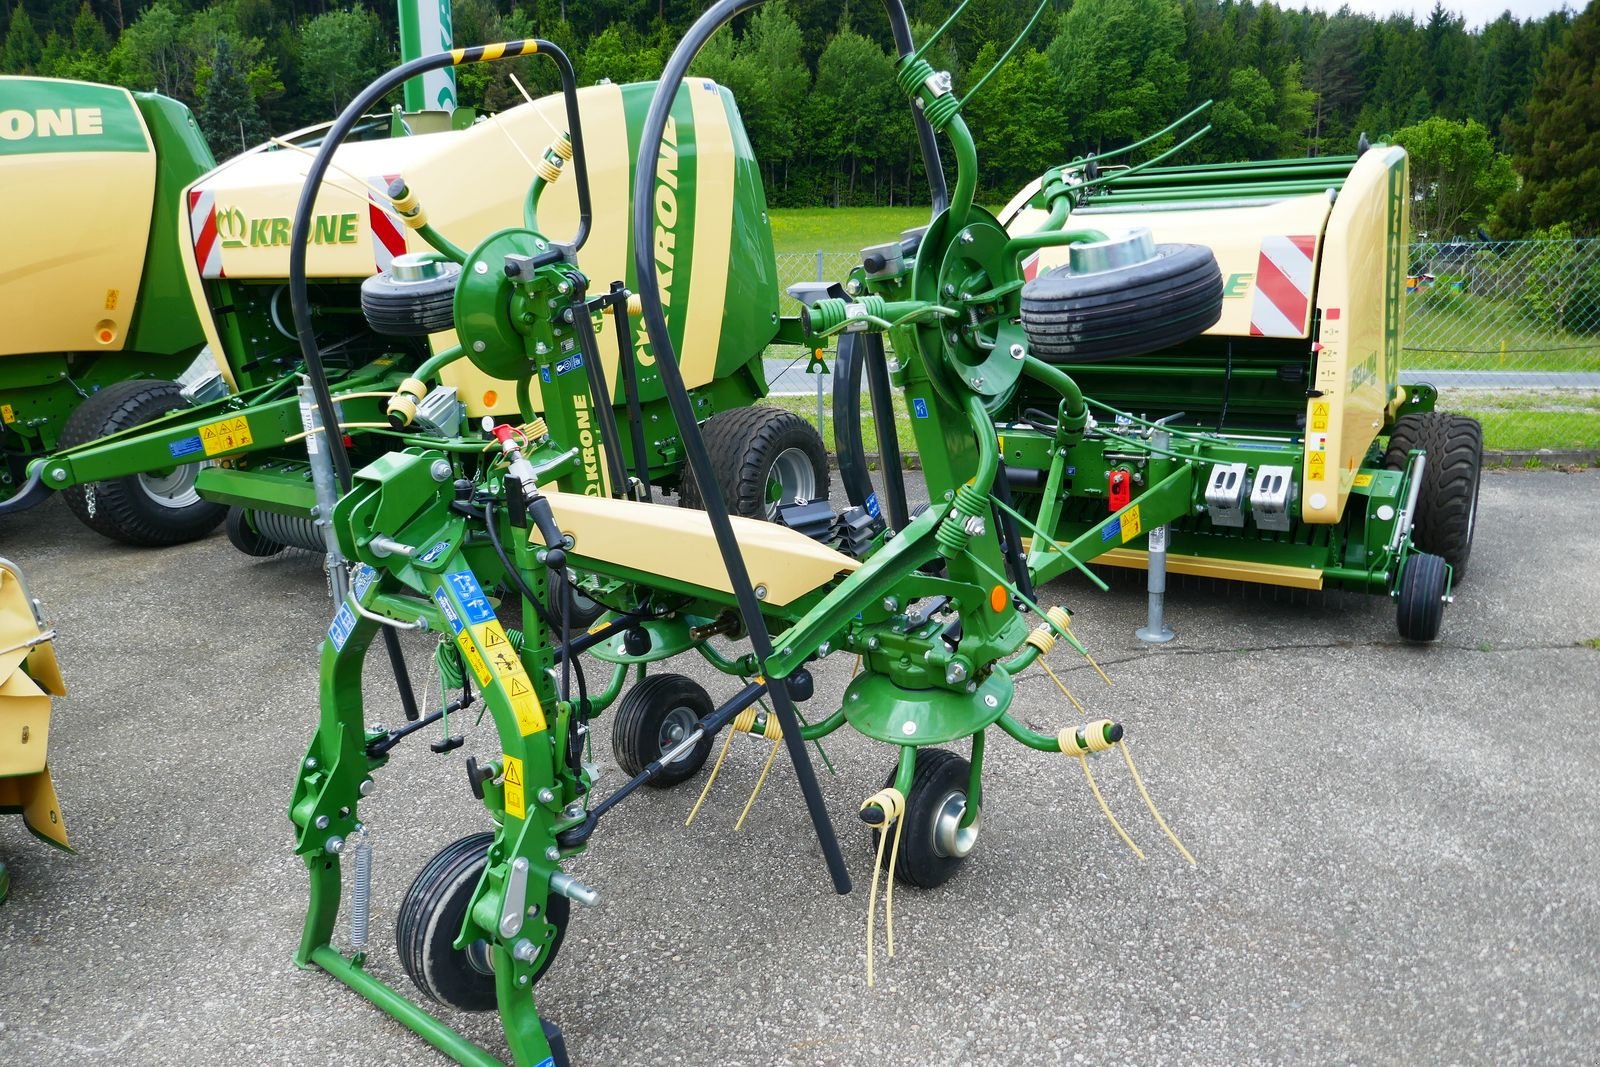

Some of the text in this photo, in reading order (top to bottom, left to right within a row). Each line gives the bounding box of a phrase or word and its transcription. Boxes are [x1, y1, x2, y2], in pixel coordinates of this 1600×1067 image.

[250, 213, 358, 247] KRNE
[1388, 169, 1401, 331] KRONE
[573, 394, 600, 482] KRONE
